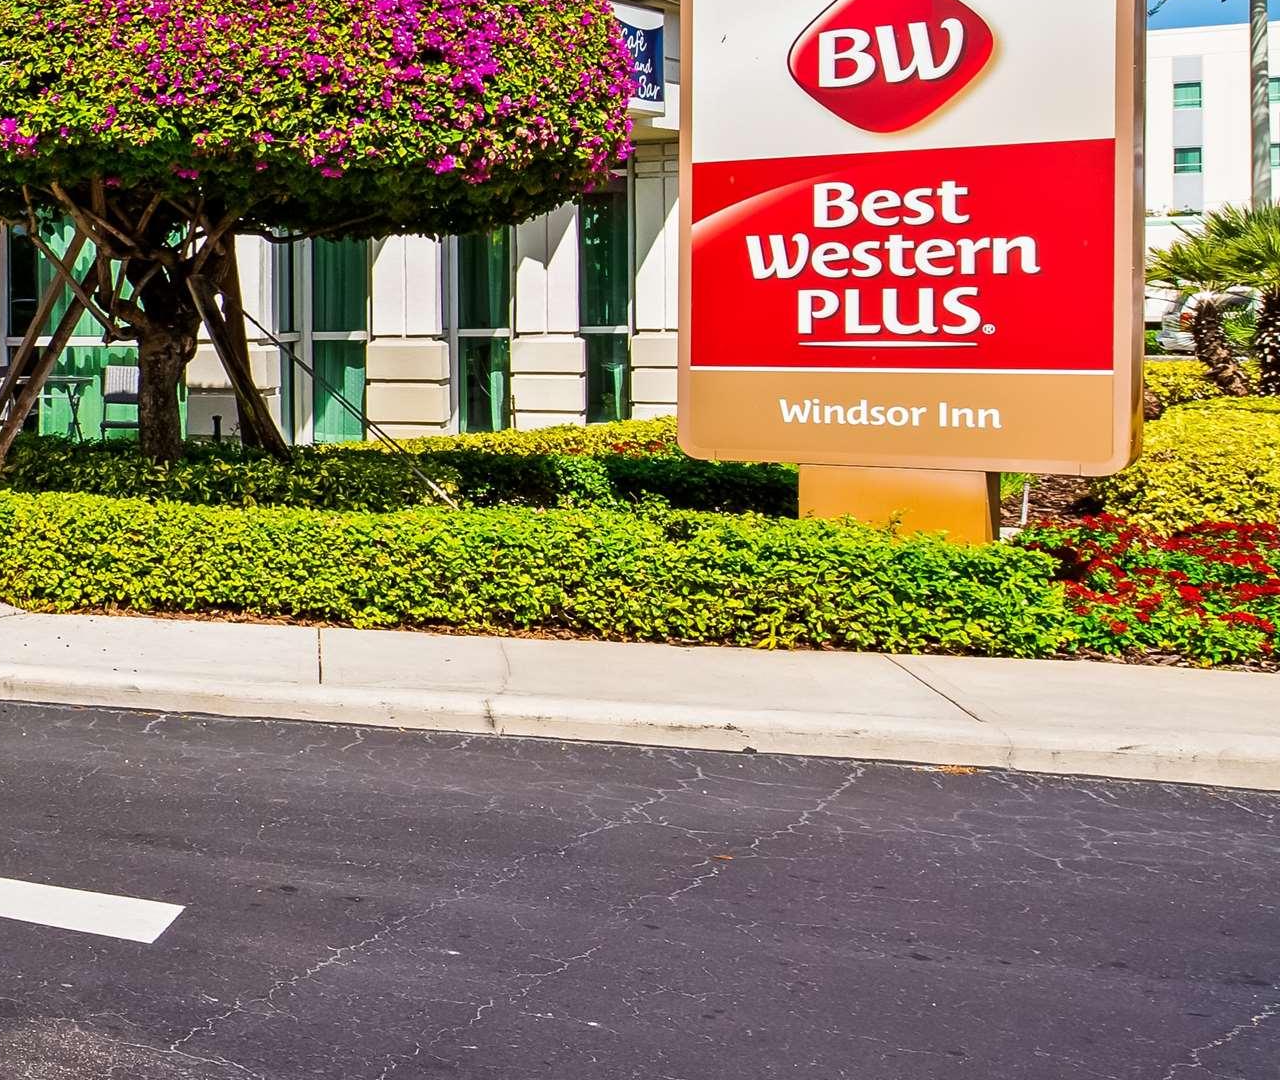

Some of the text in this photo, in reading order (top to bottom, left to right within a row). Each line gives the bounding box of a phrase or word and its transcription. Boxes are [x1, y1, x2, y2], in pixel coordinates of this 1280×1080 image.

[817, 18, 964, 89] BW
[813, 180, 970, 229] Best
[745, 233, 1041, 281] Western
[779, 398, 1003, 430] Windsor Inn
